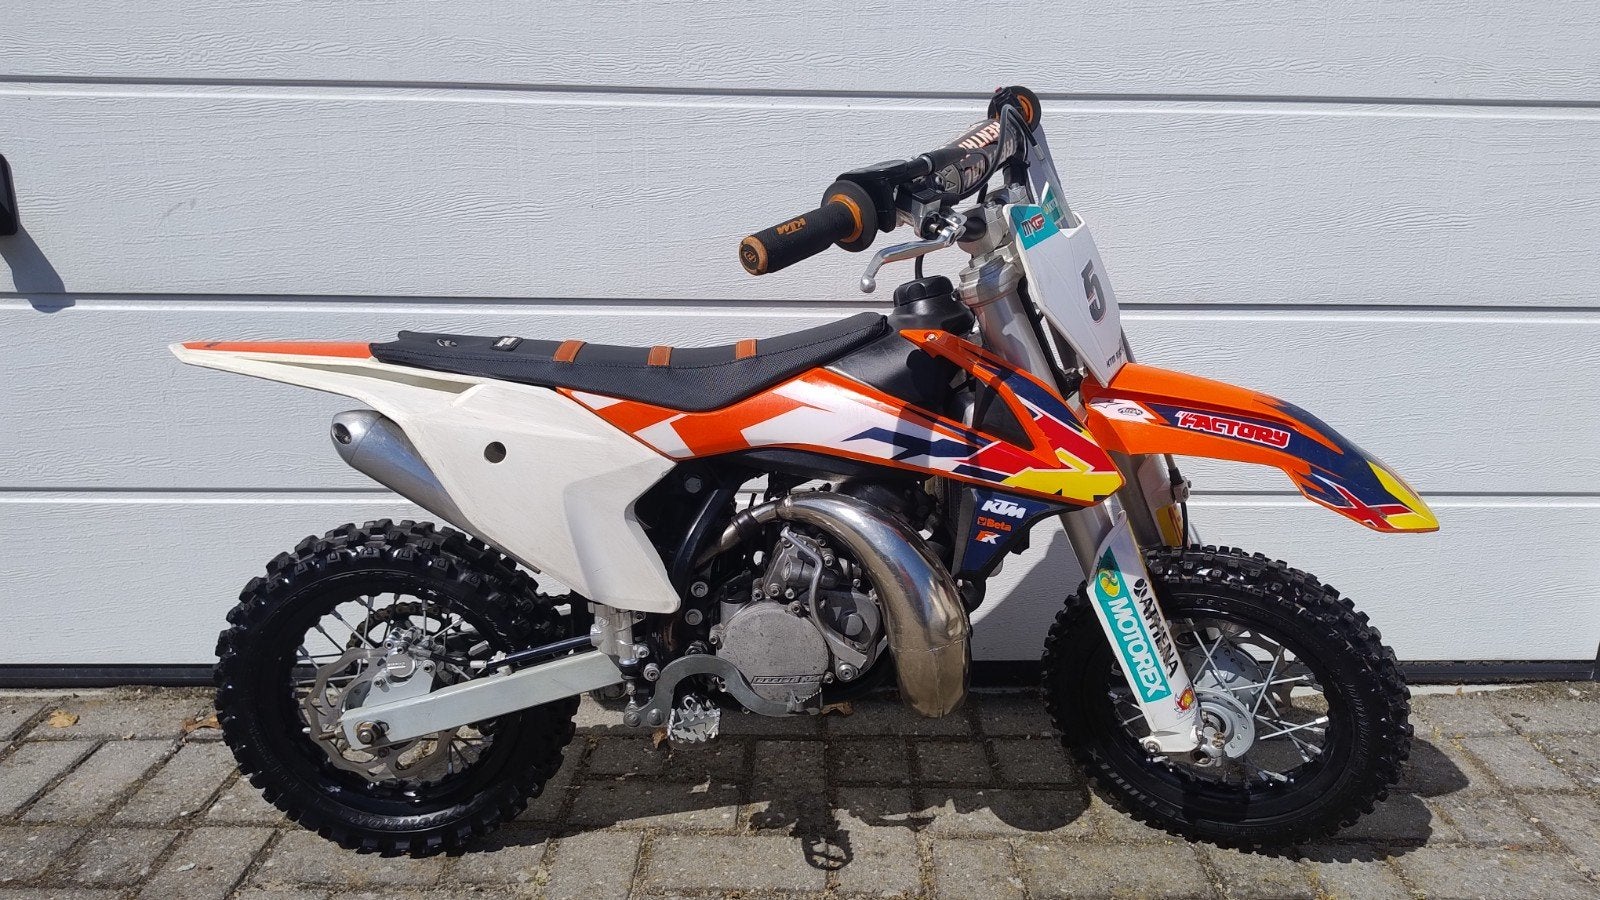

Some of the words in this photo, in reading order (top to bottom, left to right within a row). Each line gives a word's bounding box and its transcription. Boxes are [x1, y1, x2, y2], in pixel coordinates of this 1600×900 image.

[776, 217, 807, 235] KTM
[1080, 259, 1107, 323] 5
[1174, 411, 1291, 449] FACTORY
[981, 499, 1027, 519] KTM
[986, 516, 1012, 532] Beta
[1108, 597, 1166, 697] MOTOREX
[1139, 598, 1178, 678] ATHENA
